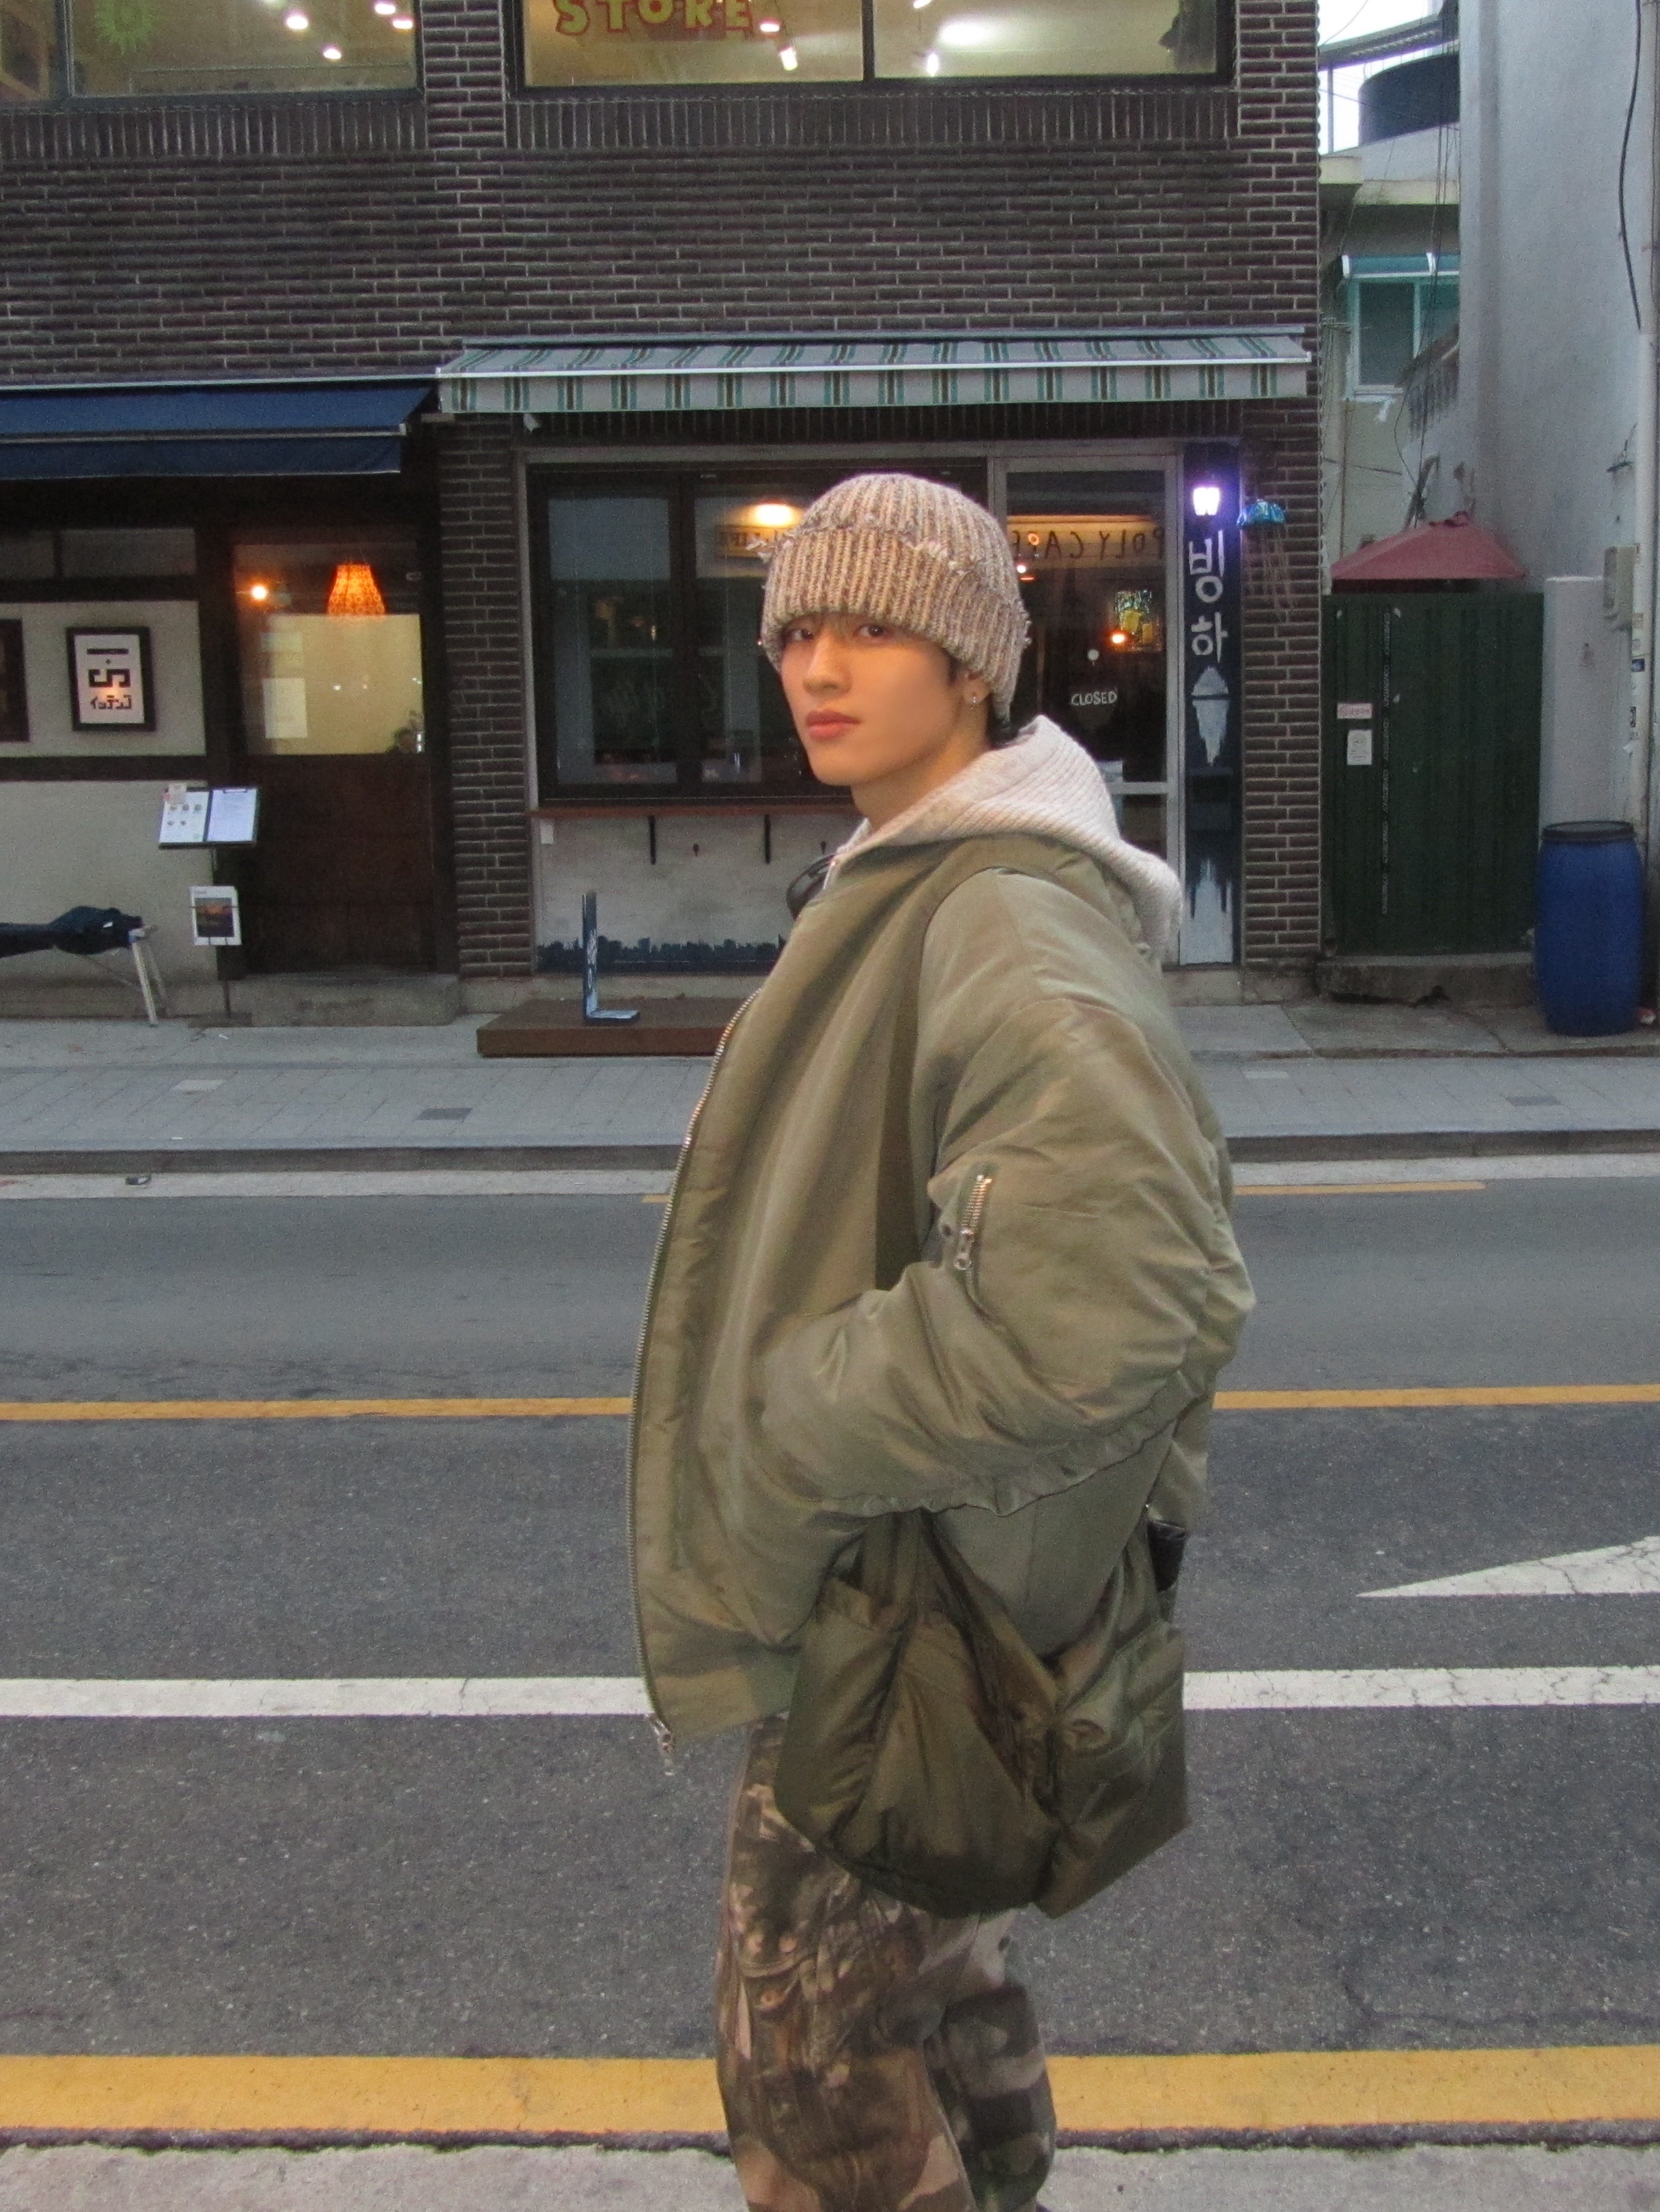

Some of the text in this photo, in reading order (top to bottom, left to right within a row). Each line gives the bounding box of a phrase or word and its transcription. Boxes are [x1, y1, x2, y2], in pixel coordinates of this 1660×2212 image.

[553, 0, 752, 35] STORE
[1189, 530, 1228, 663] 빙하
[1071, 690, 1118, 706] CLOSED
